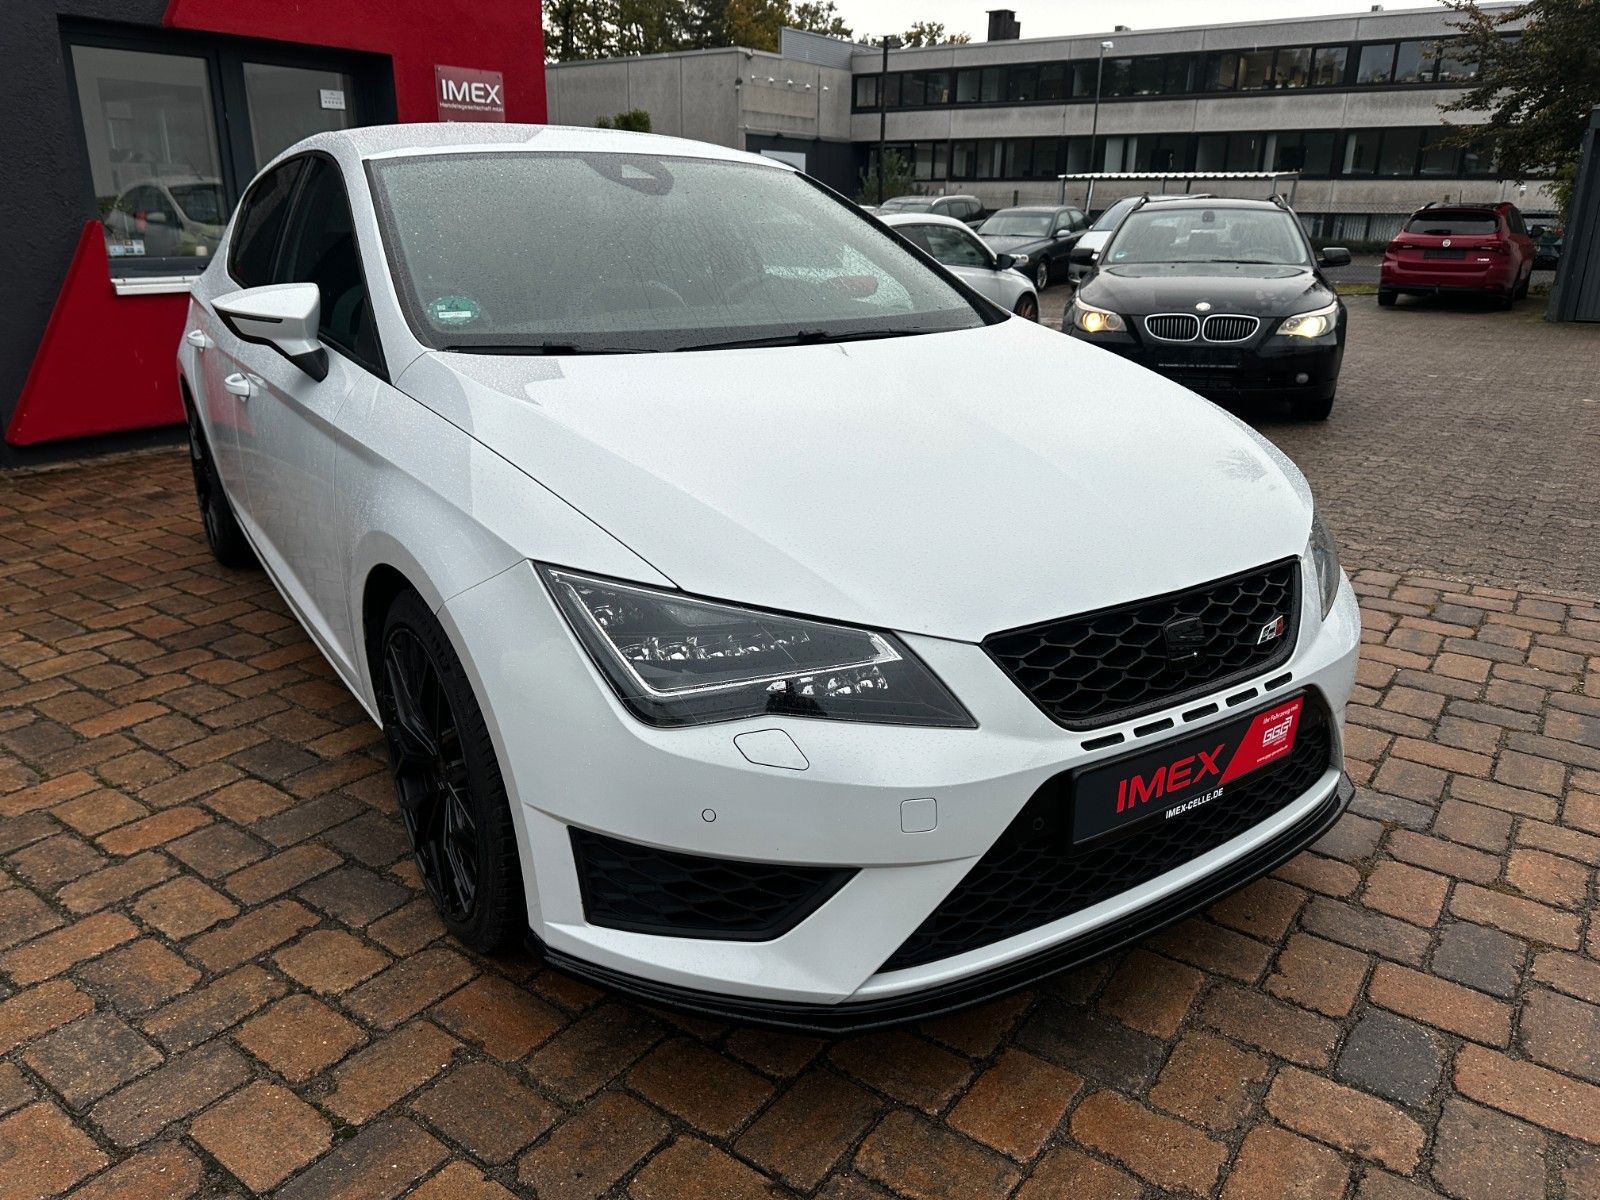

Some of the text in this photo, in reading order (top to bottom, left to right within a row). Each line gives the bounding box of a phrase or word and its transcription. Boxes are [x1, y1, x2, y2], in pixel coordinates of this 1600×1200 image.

[441, 79, 501, 105] IMEX
[1263, 718, 1291, 744] GGG
[1116, 743, 1226, 813] IMEX
[1165, 788, 1224, 819] IMEX-CELLE.DE
